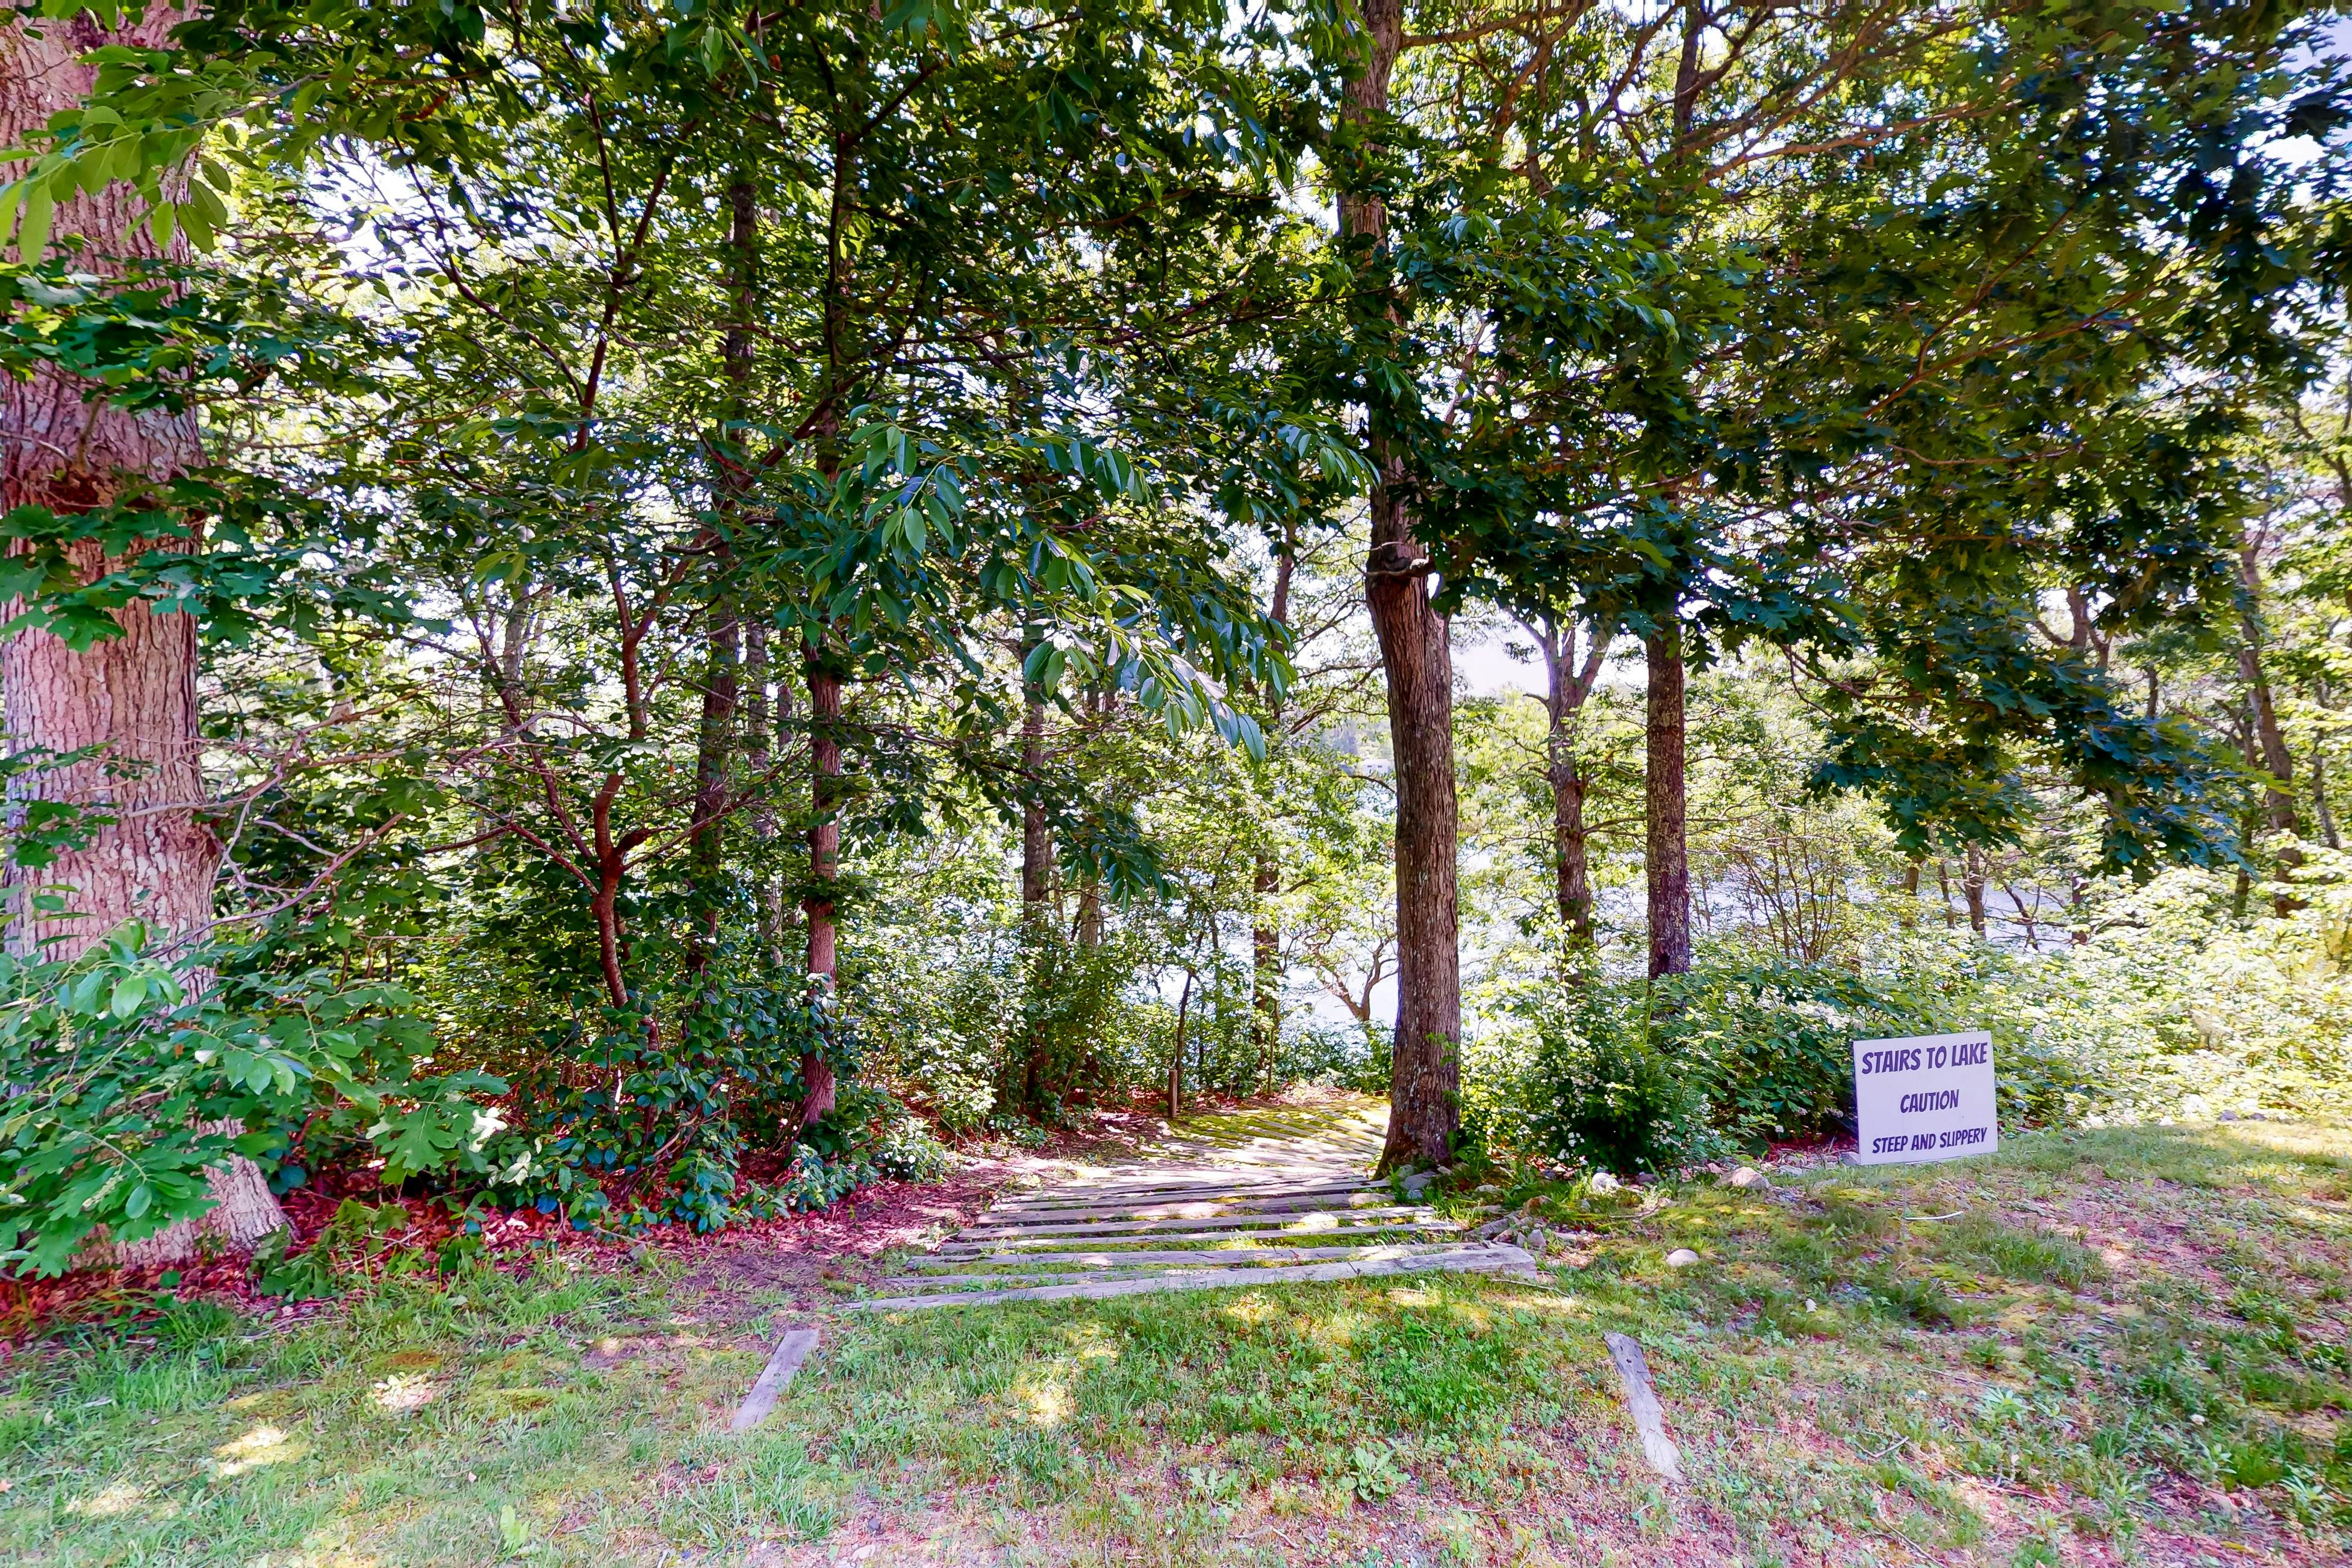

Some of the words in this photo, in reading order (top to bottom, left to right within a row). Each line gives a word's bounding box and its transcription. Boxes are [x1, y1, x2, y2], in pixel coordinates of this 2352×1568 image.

[1862, 1048, 1921, 1074] STAIRS
[1927, 1046, 1947, 1069] TO
[1952, 1042, 1987, 1066] LAKE
[1900, 1089, 1959, 1113] CAUTION
[1873, 1134, 1908, 1154] STEEP
[1911, 1133, 1936, 1151] AND
[1940, 1127, 1987, 1148] SLIPPERY
